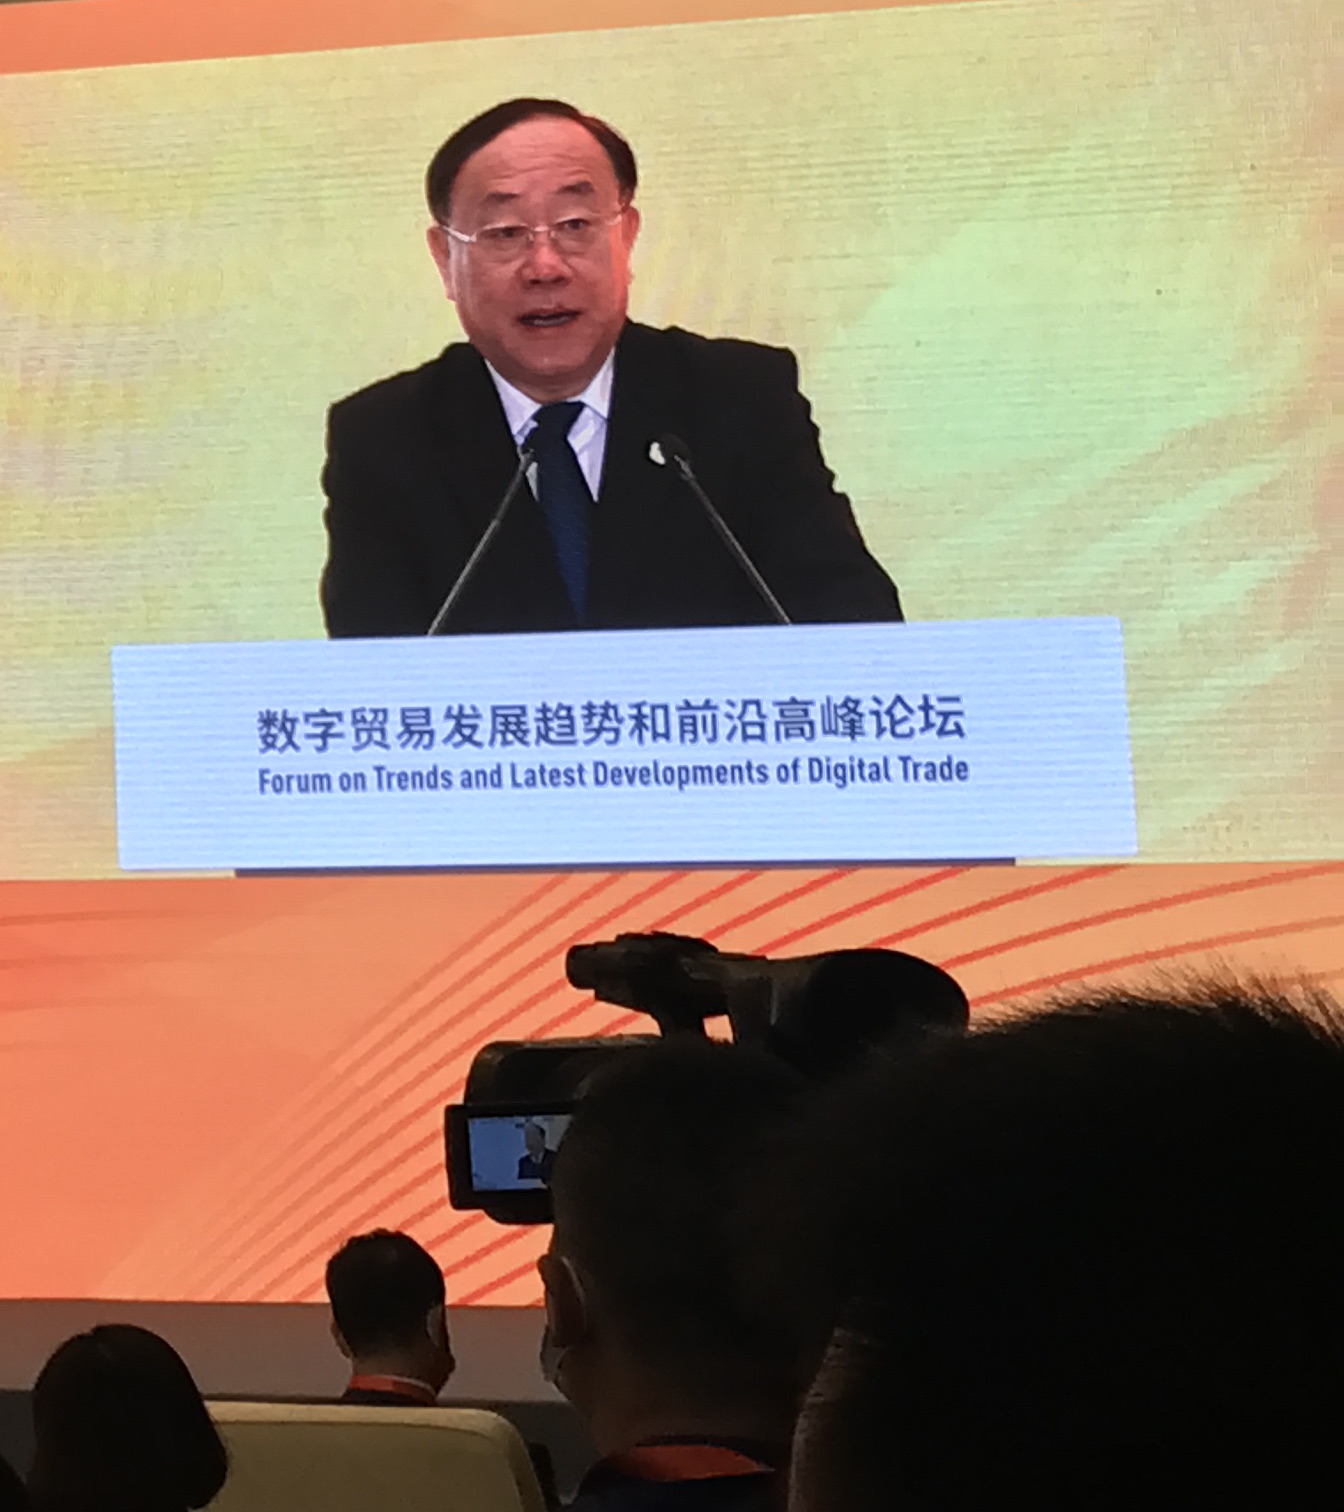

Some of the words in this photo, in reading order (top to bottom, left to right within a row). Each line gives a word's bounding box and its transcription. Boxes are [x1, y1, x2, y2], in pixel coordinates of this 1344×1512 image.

[257, 694, 966, 755] 数字贸易发展趋势和前沿高峰论坛
[258, 768, 332, 795] Forum
[339, 772, 367, 793] on
[373, 765, 453, 792] Trends
[461, 763, 502, 790] and
[510, 761, 586, 789] Latest
[593, 758, 769, 792] Developments
[777, 756, 801, 784] of
[808, 754, 891, 790] Digital
[898, 753, 969, 783] Trade
